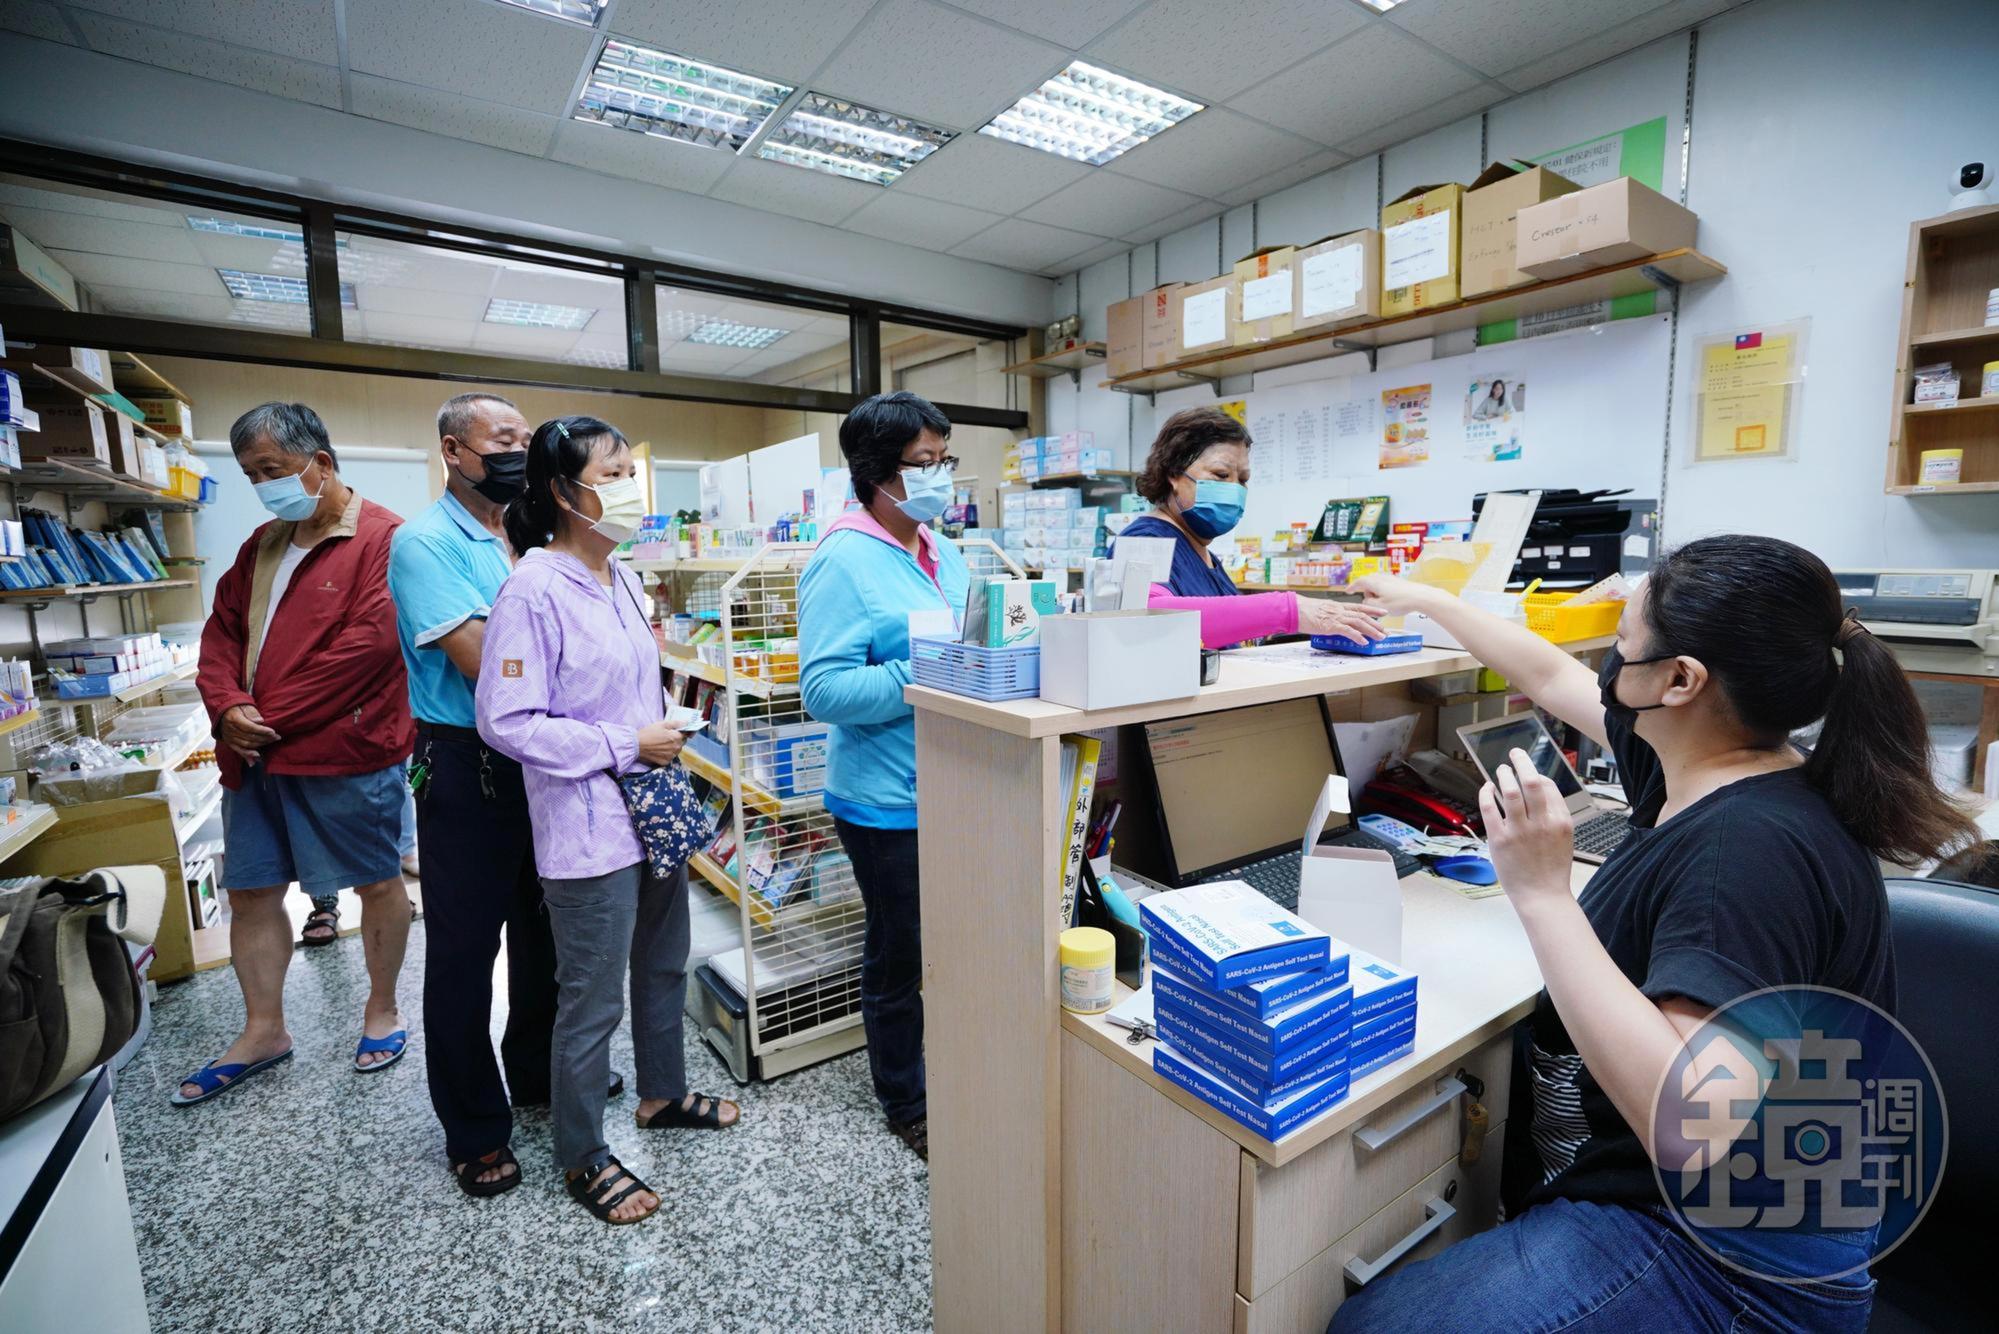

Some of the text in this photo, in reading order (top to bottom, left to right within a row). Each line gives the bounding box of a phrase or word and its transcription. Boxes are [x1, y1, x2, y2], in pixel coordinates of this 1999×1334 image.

[1152, 948, 1187, 972] SARS-CoV-2
[1237, 992, 1257, 1008] Nasal
[1226, 951, 1324, 980] SARS-CoV-2 Antigen Self Test Nasal
[1268, 968, 1346, 1008] SARS-CoV-2 Antigen Self Test Nasal
[1156, 981, 1269, 1043] SARS-CoV-2 Antigen Self Test Nasal
[1280, 1024, 1306, 1043] SARS-CoV-2
[1307, 1016, 1322, 1027] Antigen
[1322, 1011, 1331, 1020] Self
[1339, 1000, 1350, 1009] Nasal
[1157, 1008, 1268, 1072] SARS-CoV-2 Antigen Self Test Nasal
[1159, 1024, 1259, 1095] SARS-CoV-2 Antigen Self Test Nasal
[1280, 1028, 1349, 1072] SARS-CoV-2 Antigen Self Test Nasal
[1157, 1059, 1267, 1130] SARS-CoV-2 Antigen Self Test Nasal
[1271, 1079, 1299, 1095] SARS-CoV-2
[1300, 1071, 1317, 1082] Antigen
[1335, 1056, 1347, 1064] Nasal
[1279, 1110, 1305, 1129] SARS-CoV-2
[1305, 1102, 1320, 1113] Antigen
[1337, 1085, 1347, 1094] Nasal
